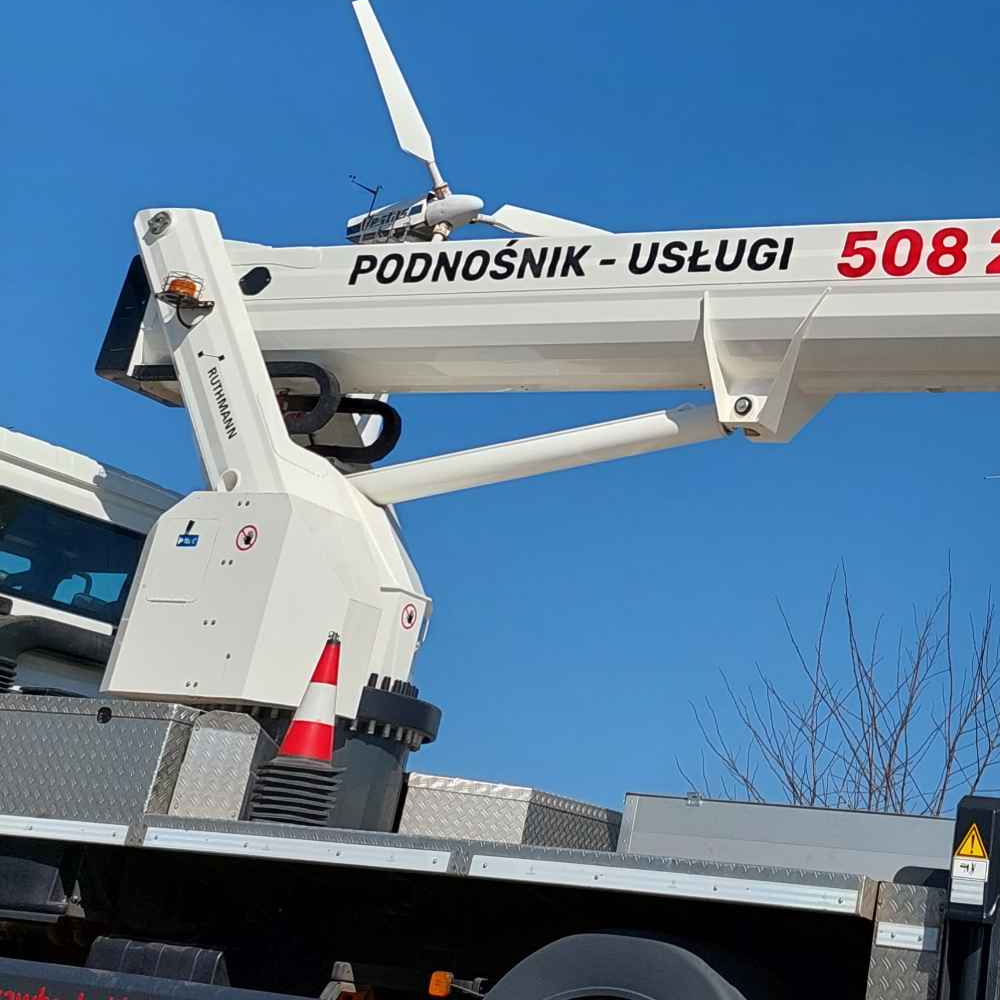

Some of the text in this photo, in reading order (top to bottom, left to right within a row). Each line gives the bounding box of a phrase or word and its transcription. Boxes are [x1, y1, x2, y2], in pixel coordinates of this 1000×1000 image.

[349, 240, 591, 285] PODNOŚNIK
[629, 238, 794, 274] USŁUGI
[837, 228, 968, 278] 508
[208, 367, 237, 440] RUTHMANN
